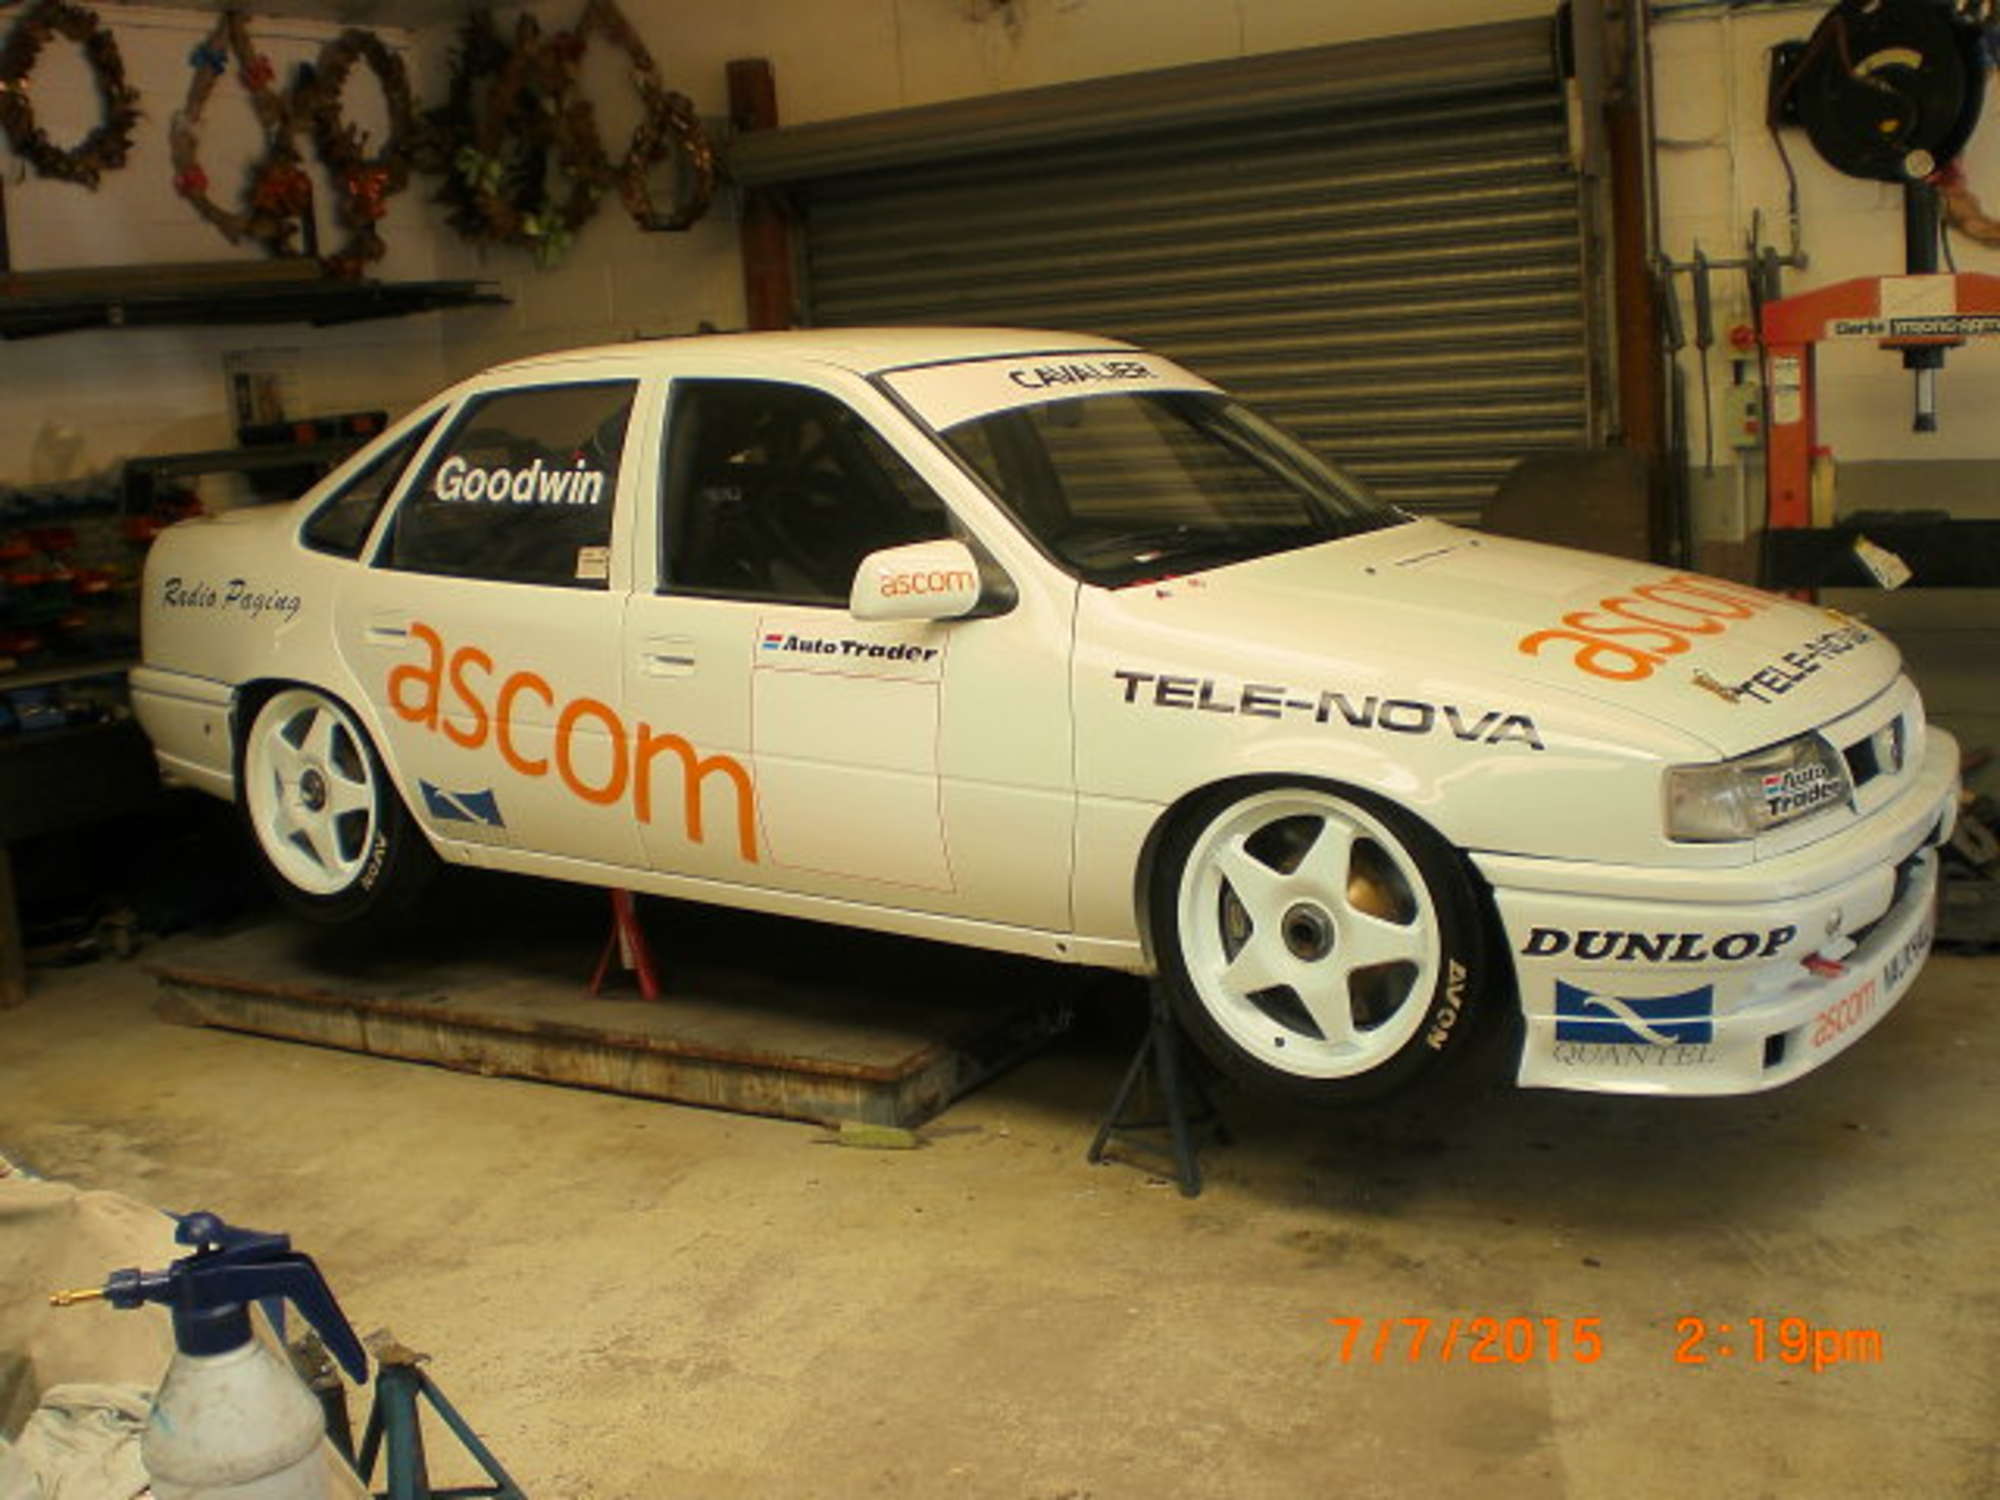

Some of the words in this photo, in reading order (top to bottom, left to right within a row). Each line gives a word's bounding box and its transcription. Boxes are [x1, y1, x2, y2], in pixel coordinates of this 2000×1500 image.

[1009, 361, 1158, 388] CAVALIER
[436, 455, 604, 504] Goodwin
[163, 576, 217, 608] Radio
[221, 578, 302, 623] Paging
[878, 569, 975, 597] ascom
[1113, 670, 1546, 751] TELE-NOVA
[387, 621, 759, 864] ascom
[1520, 924, 1798, 962] DUNLOP
[1427, 959, 1468, 1051] AVON
[1552, 1044, 1724, 1067] QUANTEL
